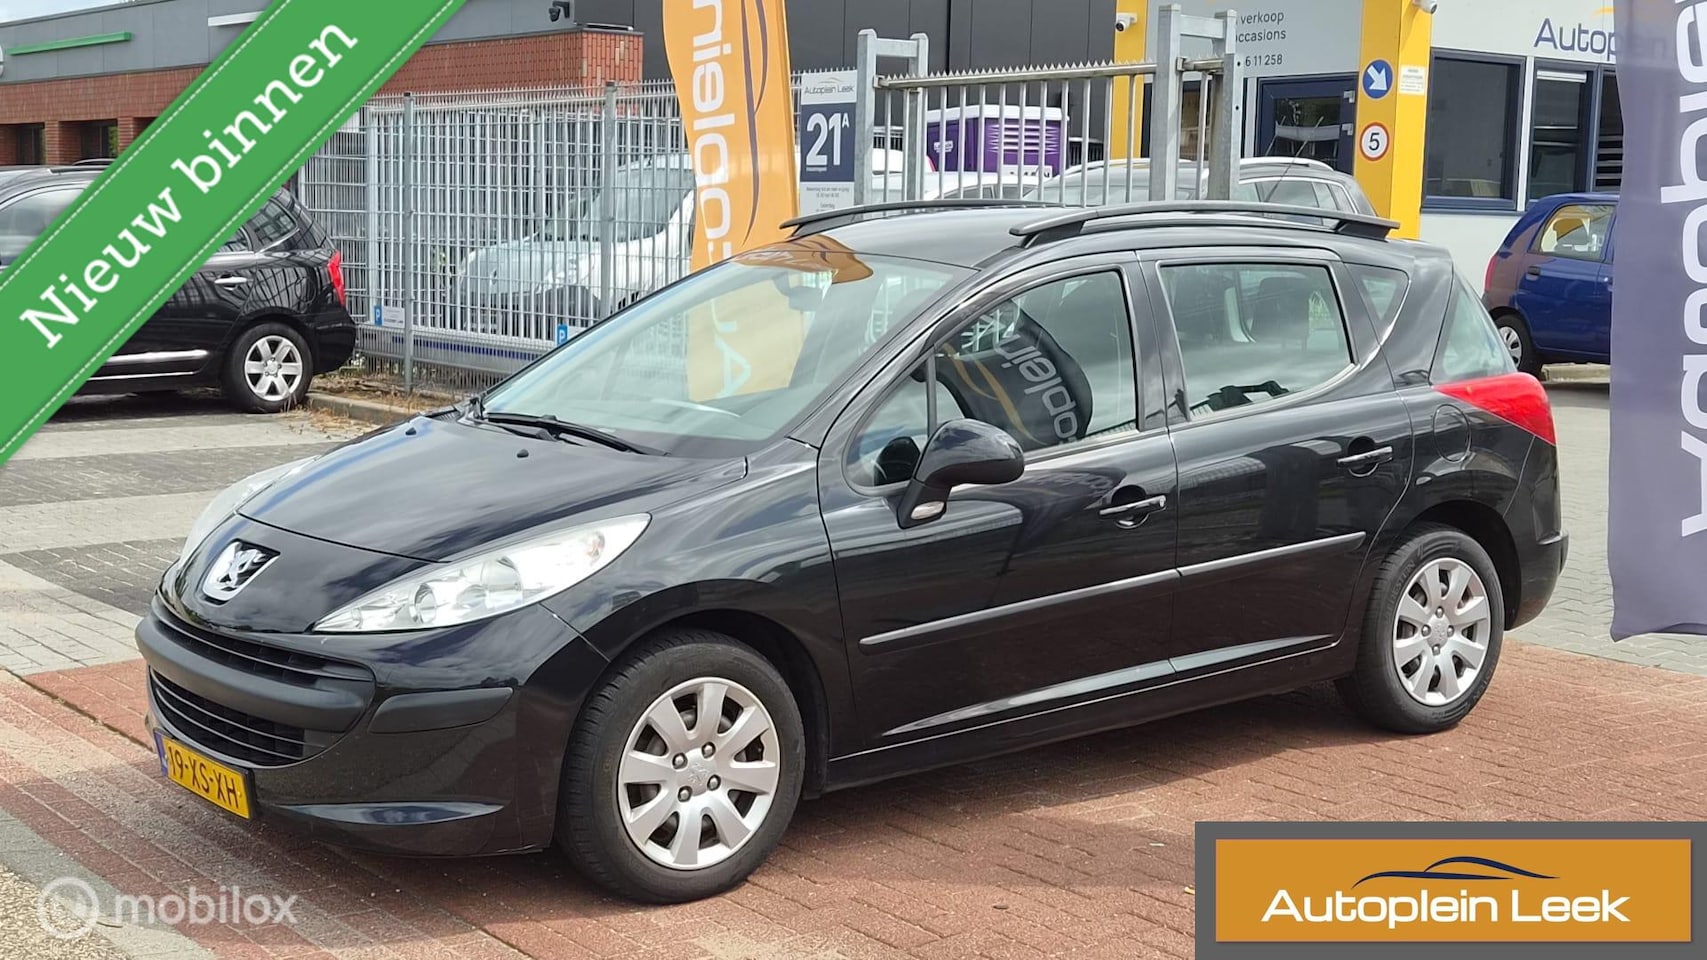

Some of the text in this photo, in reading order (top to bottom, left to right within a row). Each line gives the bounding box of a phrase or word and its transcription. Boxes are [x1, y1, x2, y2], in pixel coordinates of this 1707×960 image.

[1240, 11, 1285, 25] verkoop
[1235, 29, 1287, 43] ccasions
[1368, 132, 1381, 151] 5
[993, 334, 1079, 443] oplein
[168, 746, 240, 809] 19-XS-XH
